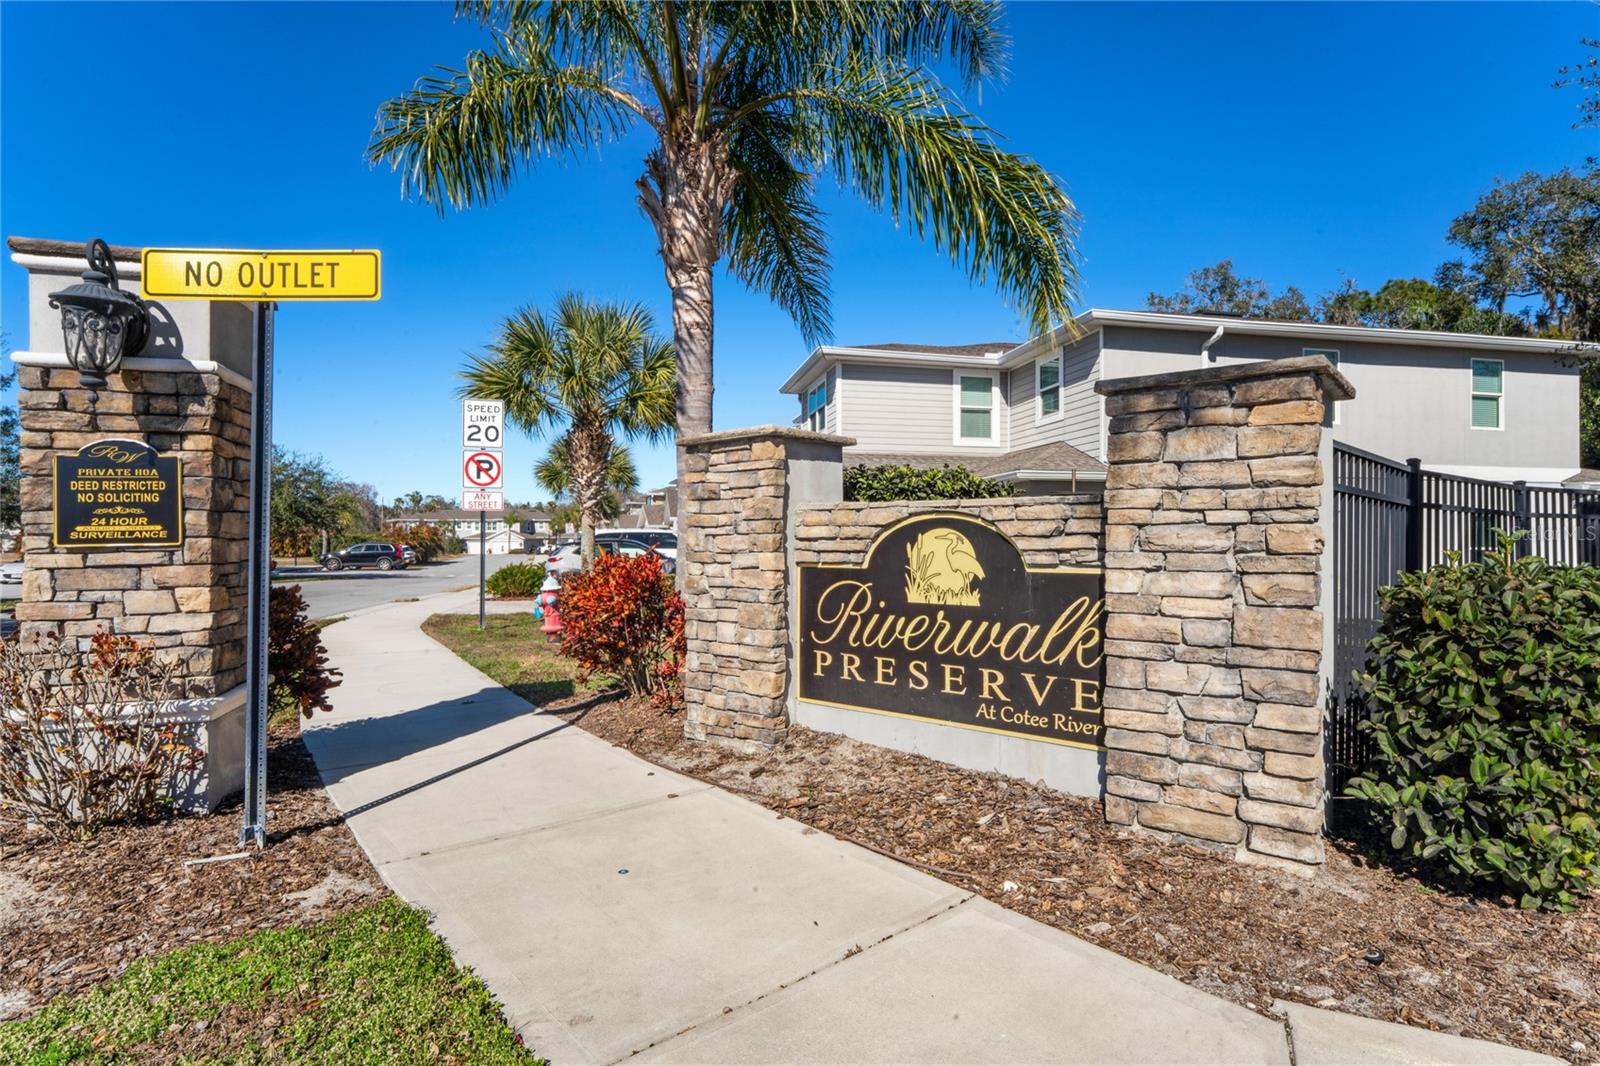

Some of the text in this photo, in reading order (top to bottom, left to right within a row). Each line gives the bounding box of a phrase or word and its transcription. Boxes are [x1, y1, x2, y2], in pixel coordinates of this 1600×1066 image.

[185, 261, 340, 288] NO OUTLET
[466, 404, 501, 414] SPEED
[470, 414, 497, 423] LIMIT
[467, 424, 500, 442] 20
[78, 468, 159, 476] PRIVATE HOA
[476, 459, 494, 480] P
[70, 480, 166, 491] DEED RESTRICTED
[77, 492, 160, 503] NO SOLICITING
[474, 493, 492, 501] ANY
[468, 500, 498, 509] STREET
[91, 517, 148, 526] 24 HOUR
[69, 530, 168, 540] SURVEILLANCE
[810, 580, 1105, 669] Riverwalk
[813, 650, 1103, 714] PRESERVE
[975, 703, 1103, 736] At Cotee River
